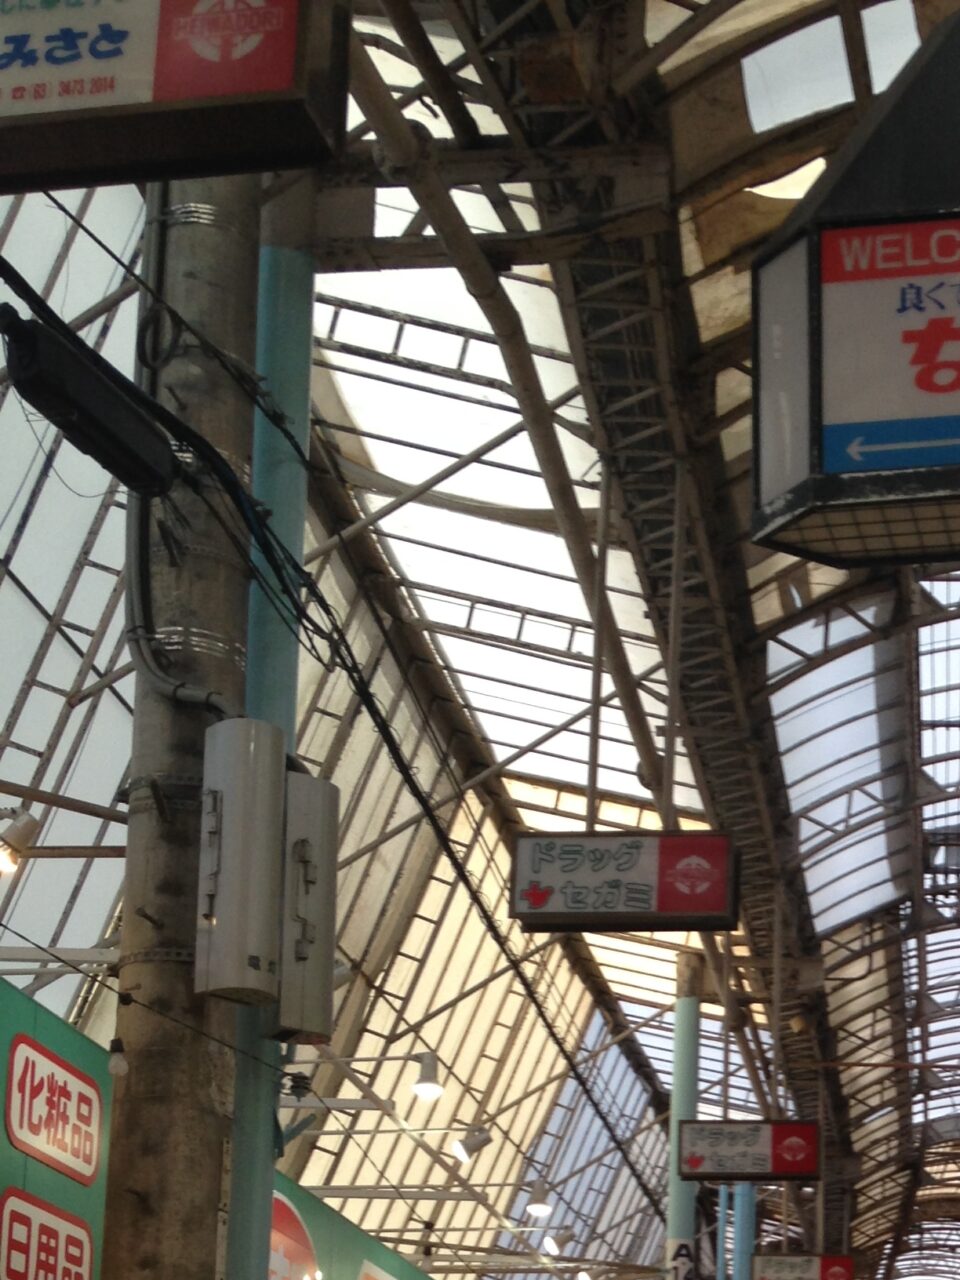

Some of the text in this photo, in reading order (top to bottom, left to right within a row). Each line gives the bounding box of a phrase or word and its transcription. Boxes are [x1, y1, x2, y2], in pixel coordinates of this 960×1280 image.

[531, 840, 644, 875] ドラッグ
[561, 879, 653, 911] セガミ
[17, 1055, 95, 1166] 化粧品
[672, 1244, 692, 1262] A
